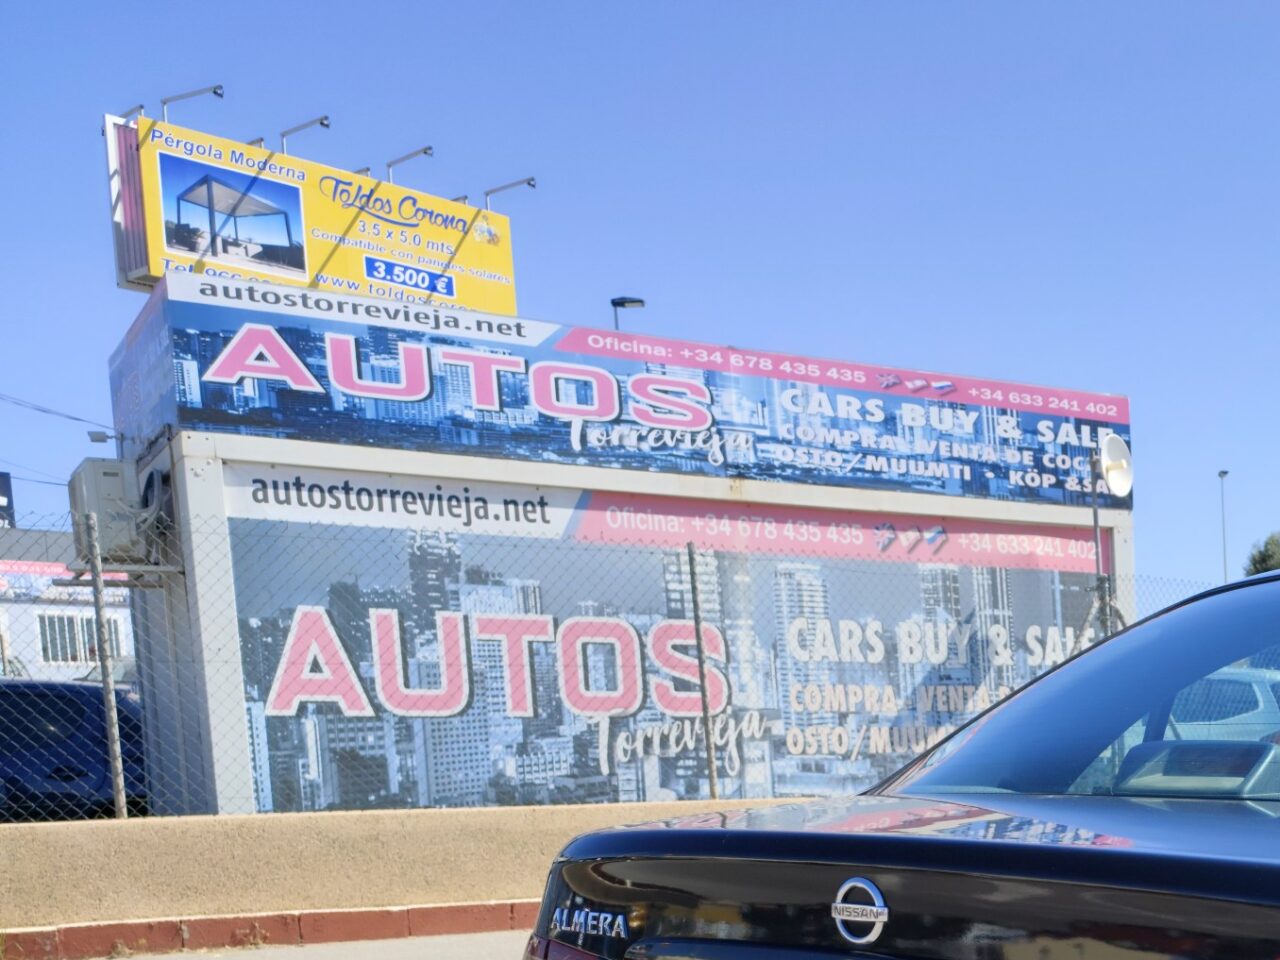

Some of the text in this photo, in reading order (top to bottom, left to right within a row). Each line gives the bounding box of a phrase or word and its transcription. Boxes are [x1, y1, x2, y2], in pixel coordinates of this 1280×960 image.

[151, 128, 305, 181] Pérgola Moderna
[319, 176, 467, 235] Toldos Corona
[311, 227, 386, 254] Compatible
[391, 248, 413, 260] con
[468, 267, 511, 285] solares
[373, 261, 449, 294] 3.500 €
[199, 281, 527, 339] autostorrevieja.net
[200, 322, 714, 432] AUTOS
[587, 334, 867, 385] Oficina: +34 678 435 435
[780, 387, 886, 423] CARS
[901, 402, 980, 436] BUY
[997, 415, 1023, 440] &
[968, 386, 1119, 418] +34 633 241 402
[567, 417, 755, 466] Torrevieja
[1004, 448, 1035, 466] DE
[251, 475, 550, 526] autostorrevieja.net
[1008, 468, 1056, 489] KÖP
[605, 505, 864, 546] Oficina: +34 678 435 435
[958, 531, 1097, 560] +34 633 241 402
[265, 605, 732, 718] AUTOS
[787, 617, 886, 665] CARS
[898, 620, 972, 666] BUY
[988, 623, 1015, 667] &
[551, 907, 627, 939] ALMERA
[834, 905, 879, 919] NISSAN
